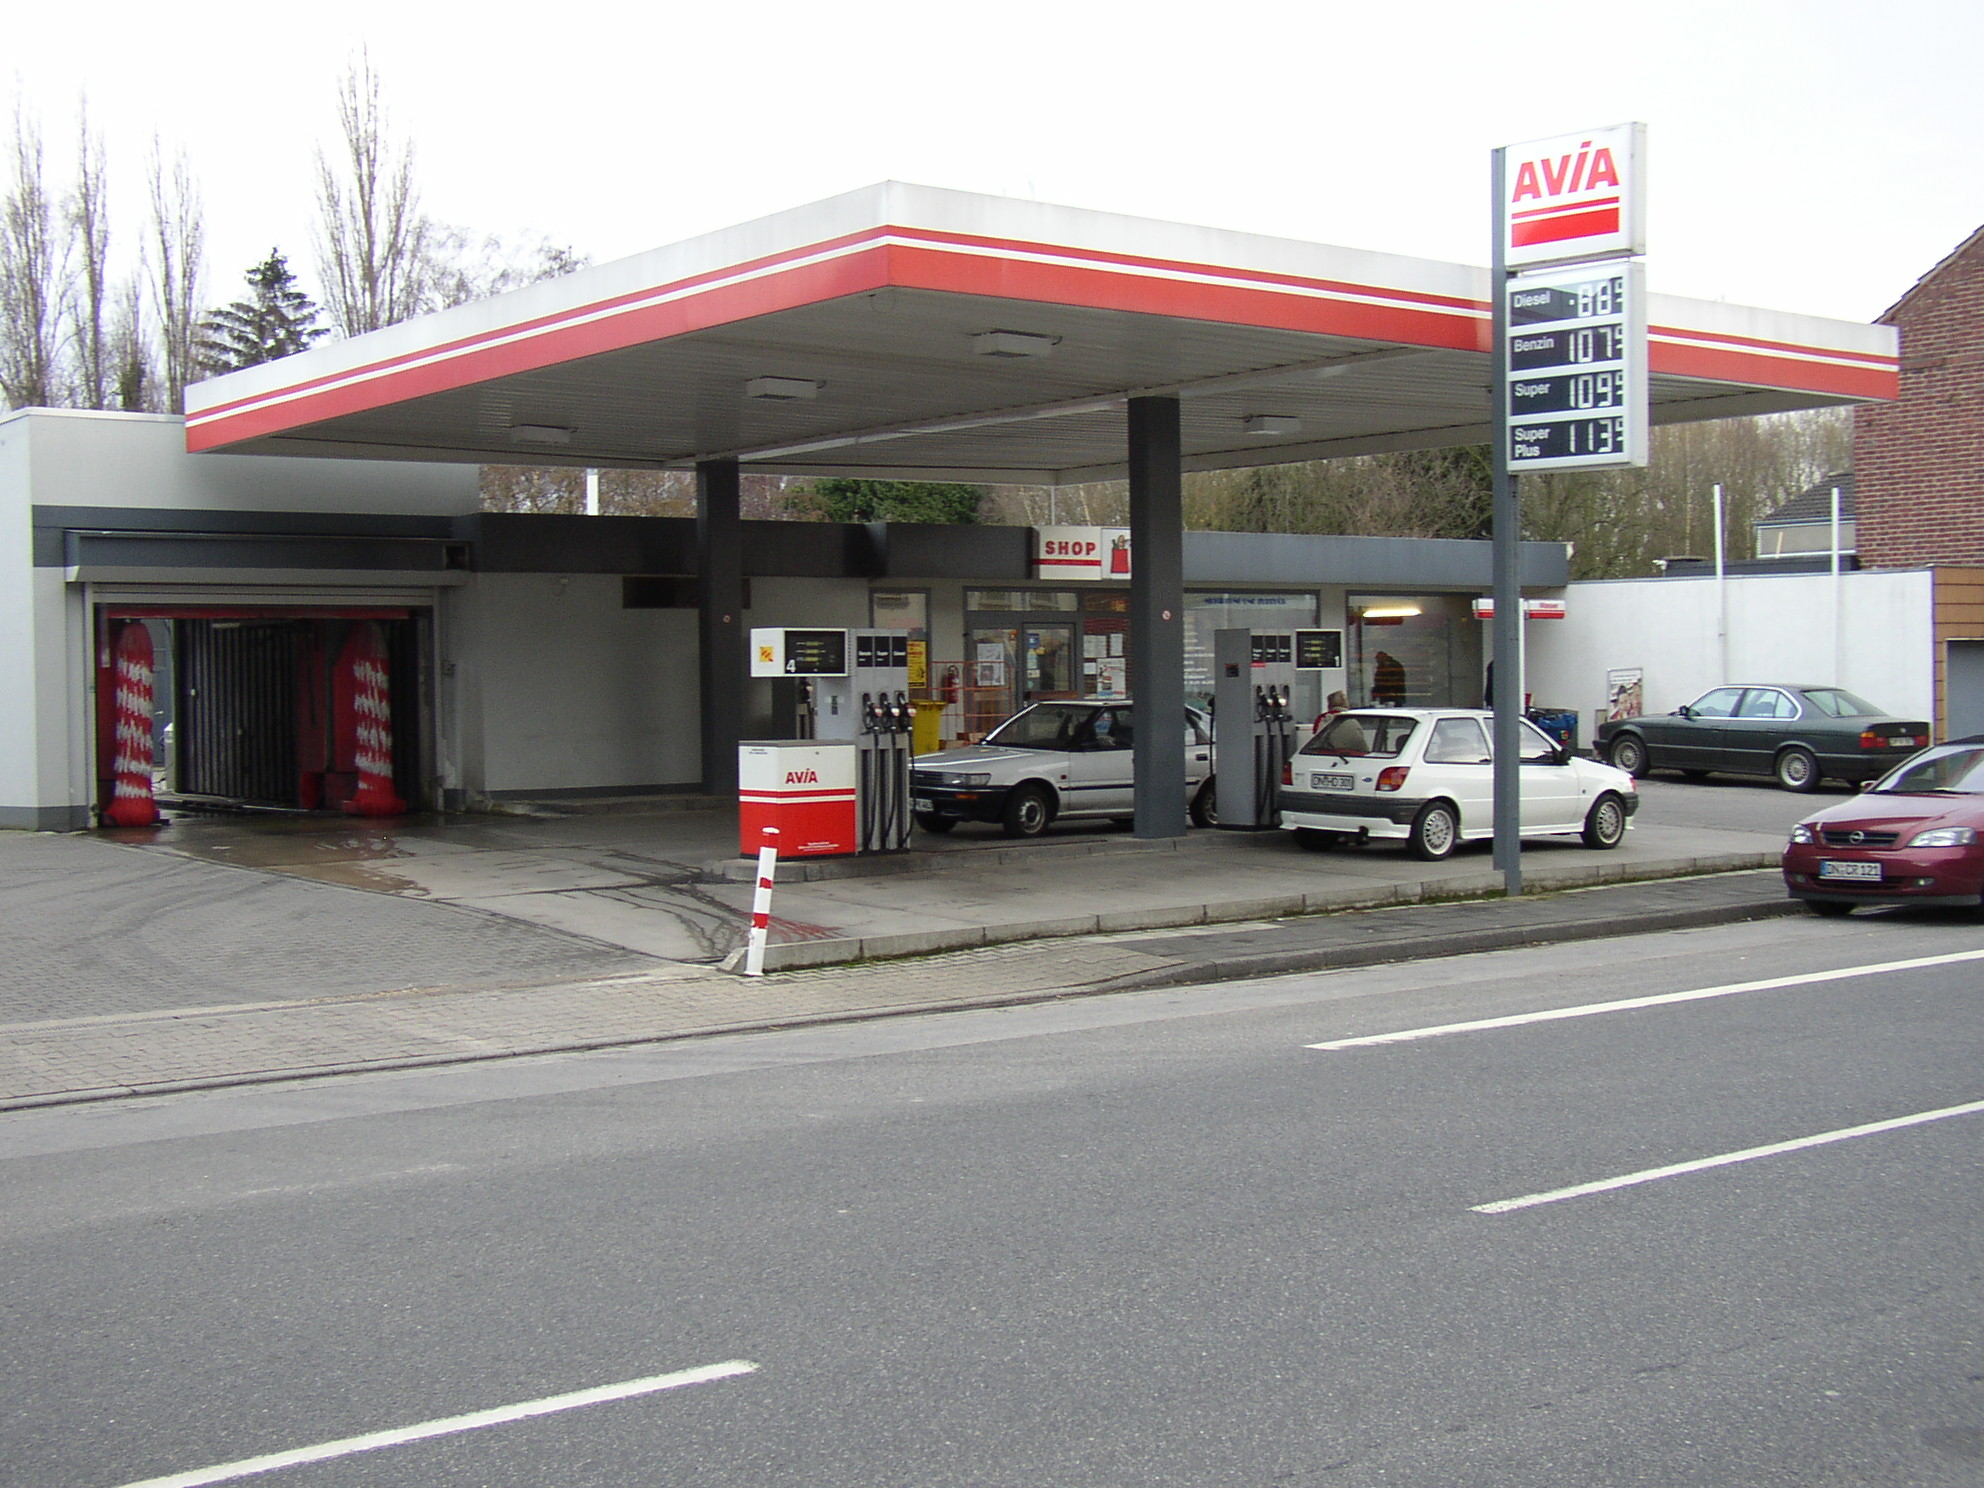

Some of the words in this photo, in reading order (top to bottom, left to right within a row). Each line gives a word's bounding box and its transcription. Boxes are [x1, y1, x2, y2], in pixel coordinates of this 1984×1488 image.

[1511, 140, 1620, 203] AVIA
[1514, 291, 1551, 308] Diesel
[1514, 336, 1555, 353] Benzin
[1514, 382, 1551, 398] Super
[1514, 427, 1551, 443] Super
[1514, 444, 1541, 458] Plus
[1045, 540, 1097, 556] SHOP
[786, 658, 797, 674] 4
[785, 767, 819, 785] AVIA
